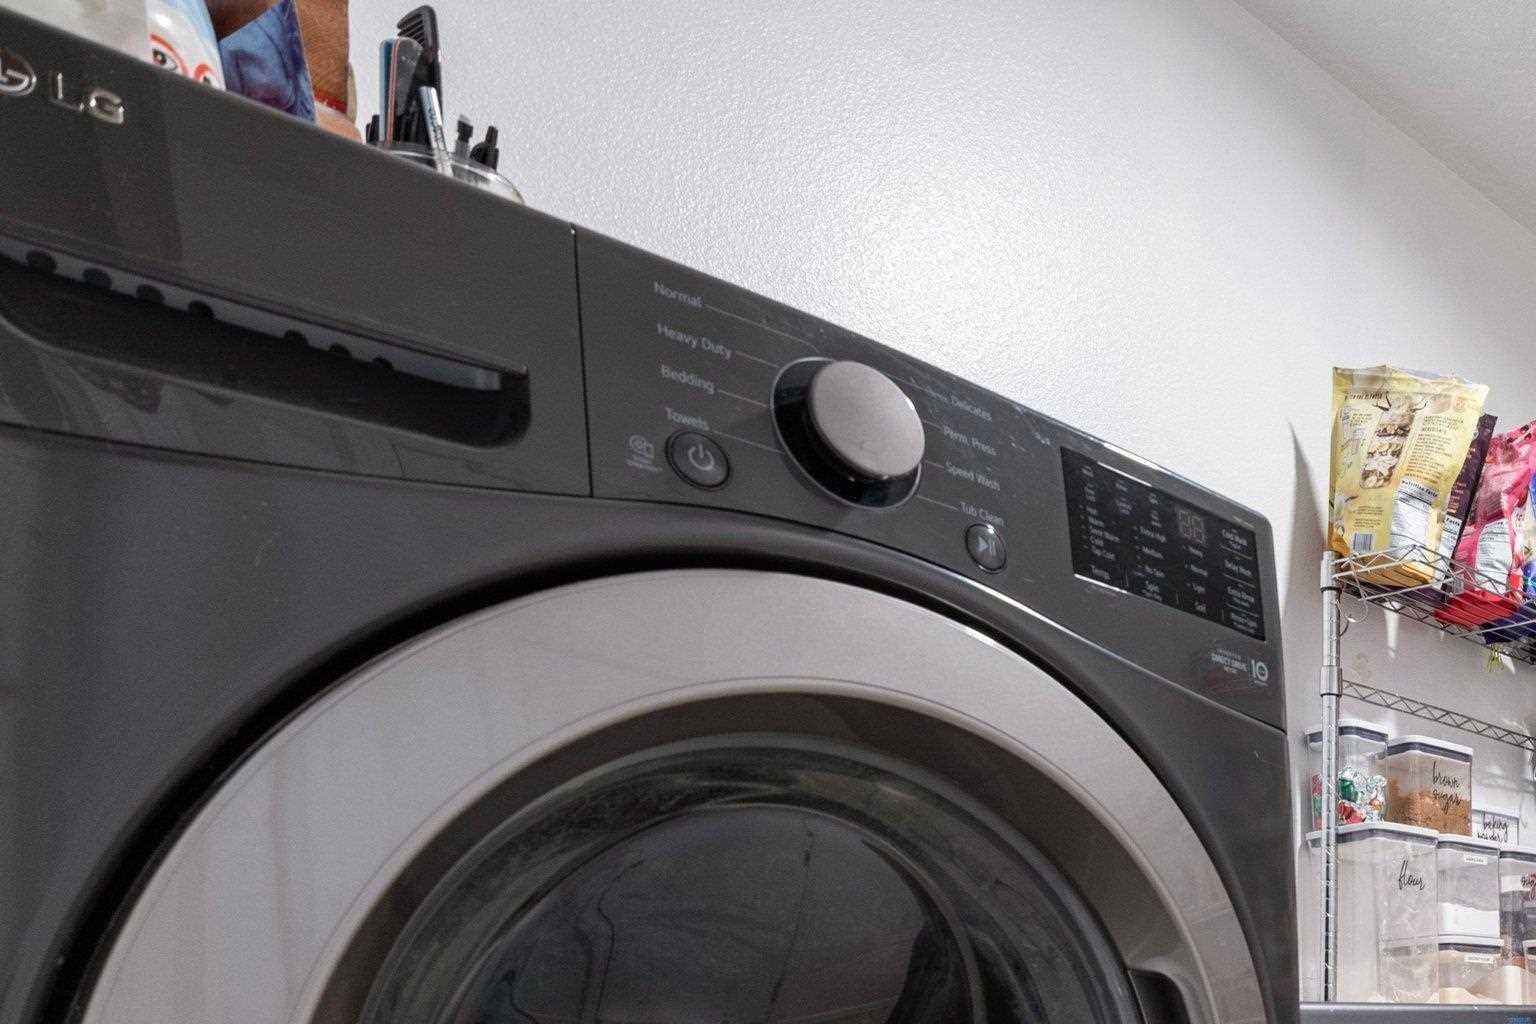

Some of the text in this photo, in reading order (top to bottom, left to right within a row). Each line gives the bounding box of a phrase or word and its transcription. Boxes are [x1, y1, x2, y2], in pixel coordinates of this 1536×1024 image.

[48, 70, 125, 124] LG
[654, 281, 703, 308] Normal
[657, 323, 732, 361] Heavy Duty
[661, 364, 716, 395] Bedding
[666, 406, 710, 431] Towels
[960, 501, 977, 517] Tub
[1398, 860, 1426, 891] flour
